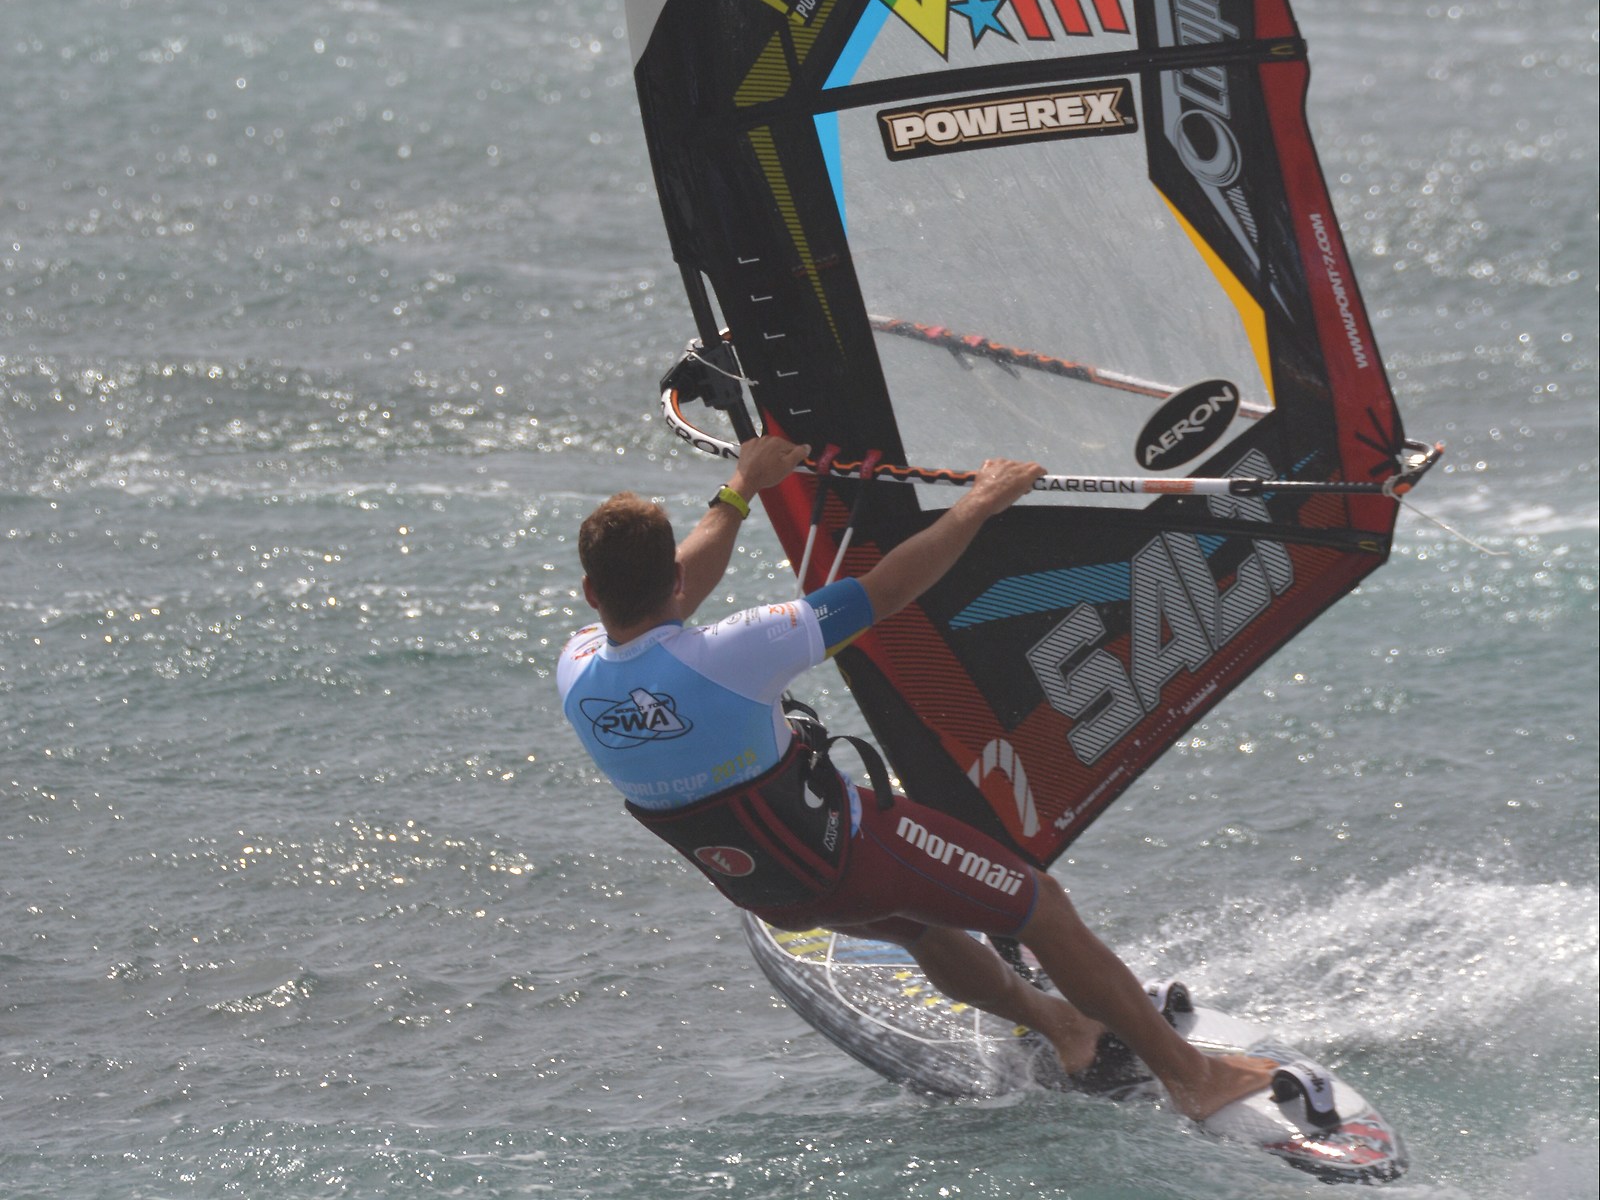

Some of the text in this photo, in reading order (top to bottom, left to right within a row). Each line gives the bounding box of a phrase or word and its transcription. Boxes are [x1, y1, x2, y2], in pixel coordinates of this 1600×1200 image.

[888, 90, 1121, 148] POWEREX
[1144, 385, 1236, 466] AERON
[1032, 477, 1135, 494] CARBON
[603, 708, 670, 734] PWA
[672, 772, 708, 795] CUP
[711, 747, 758, 784] 2015
[896, 816, 1025, 897] mormaii
